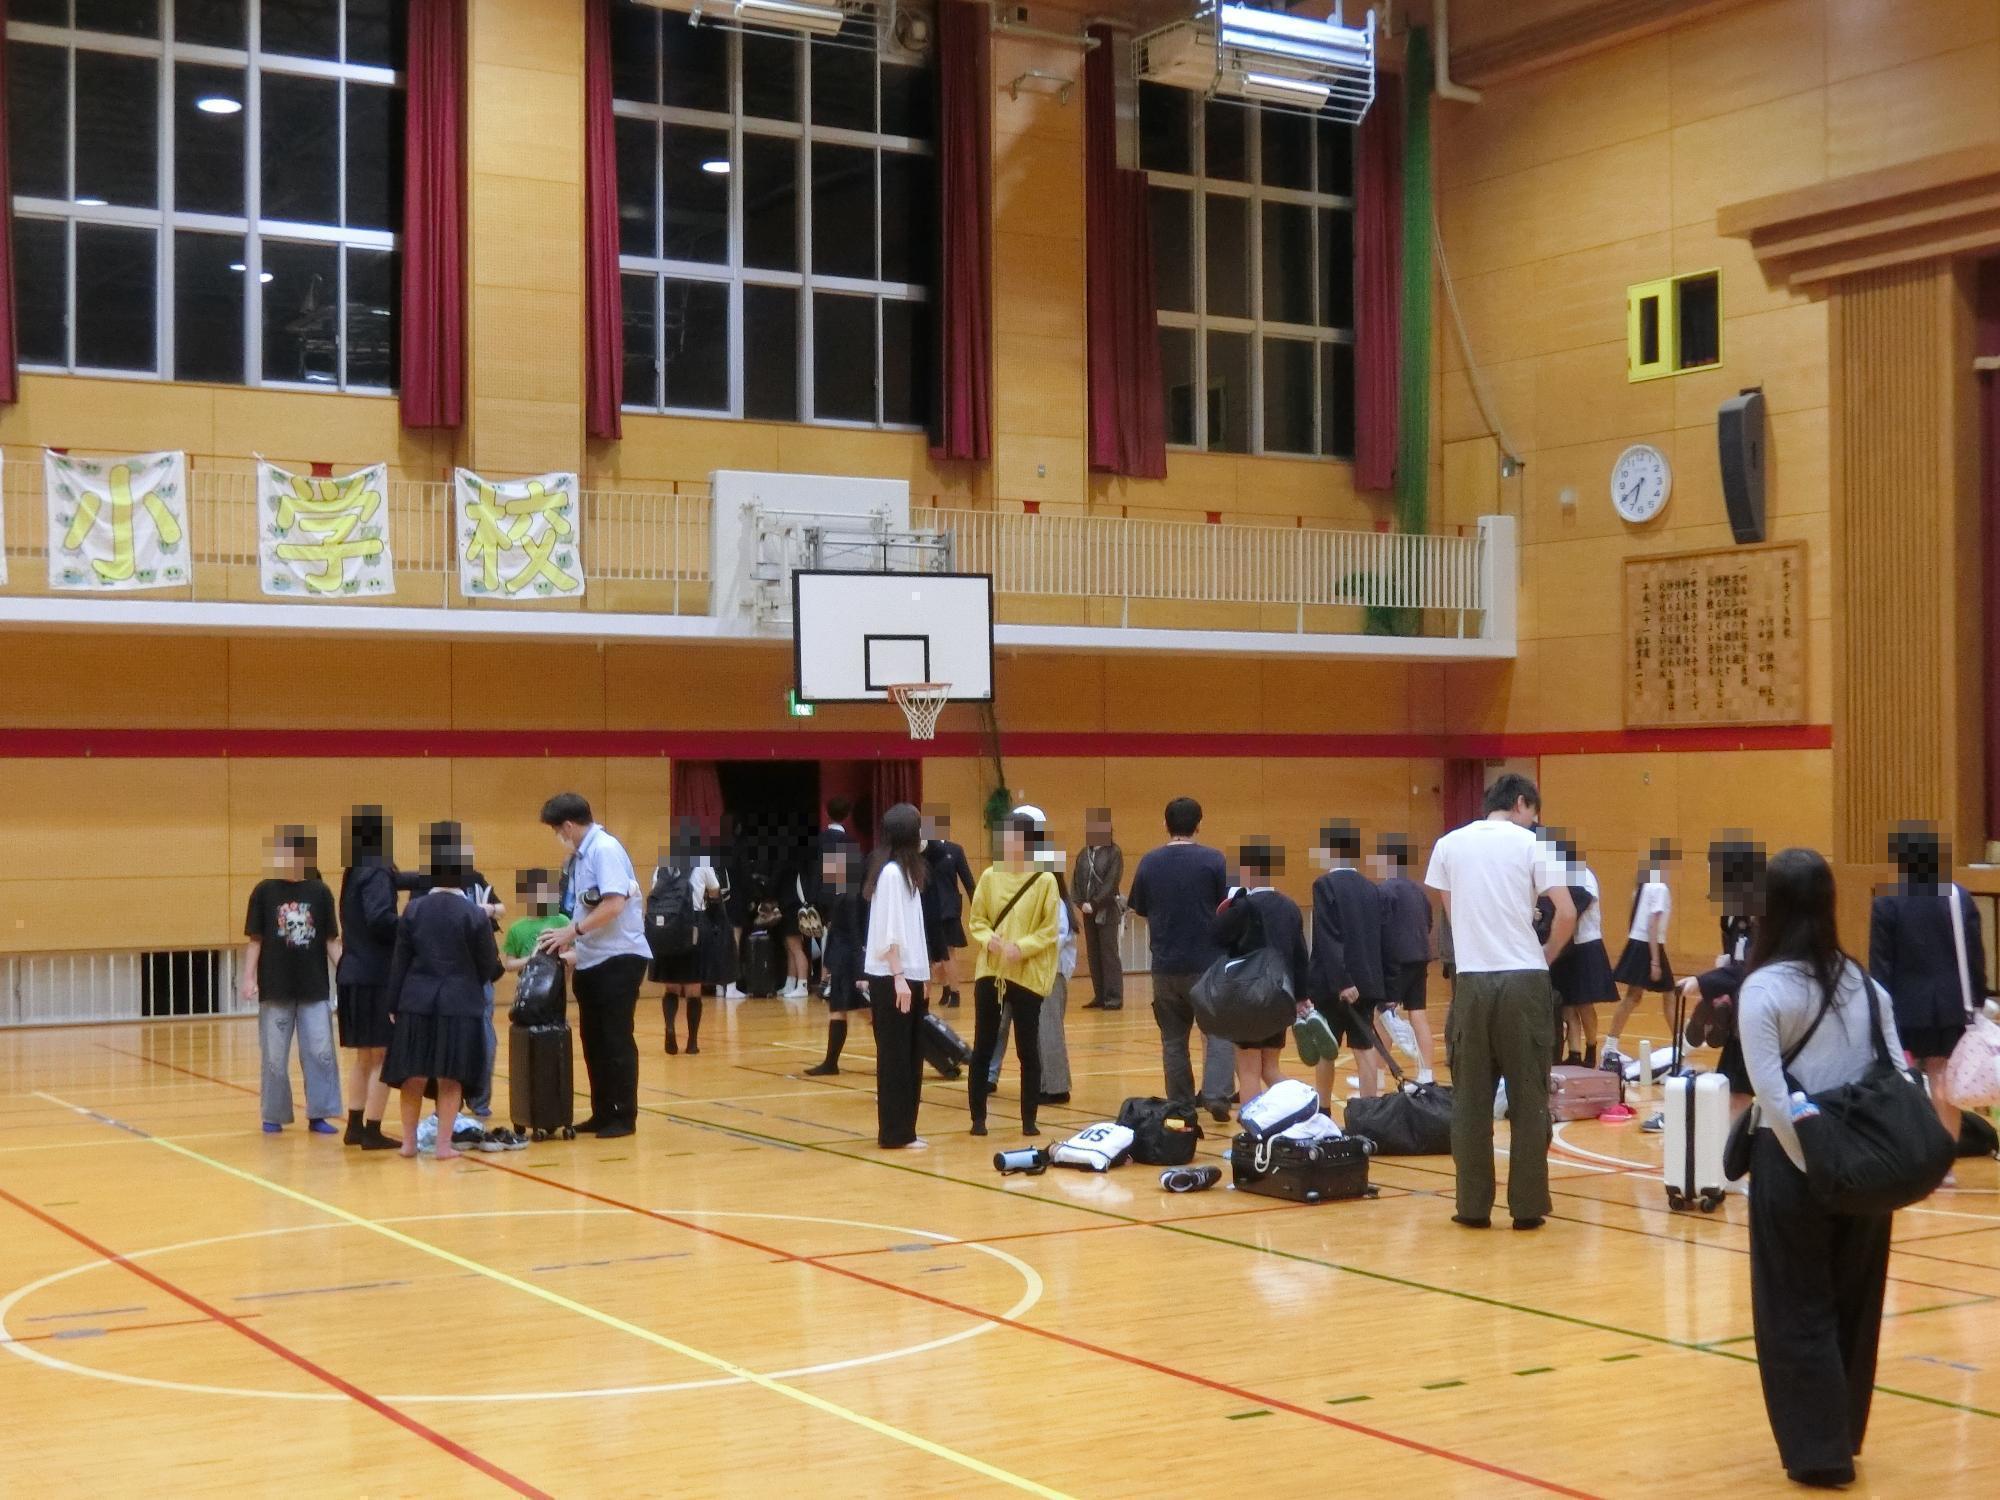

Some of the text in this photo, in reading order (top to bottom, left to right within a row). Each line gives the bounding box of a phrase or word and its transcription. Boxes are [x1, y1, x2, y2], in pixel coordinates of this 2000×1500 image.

[64, 464, 578, 593] 小 学 校
